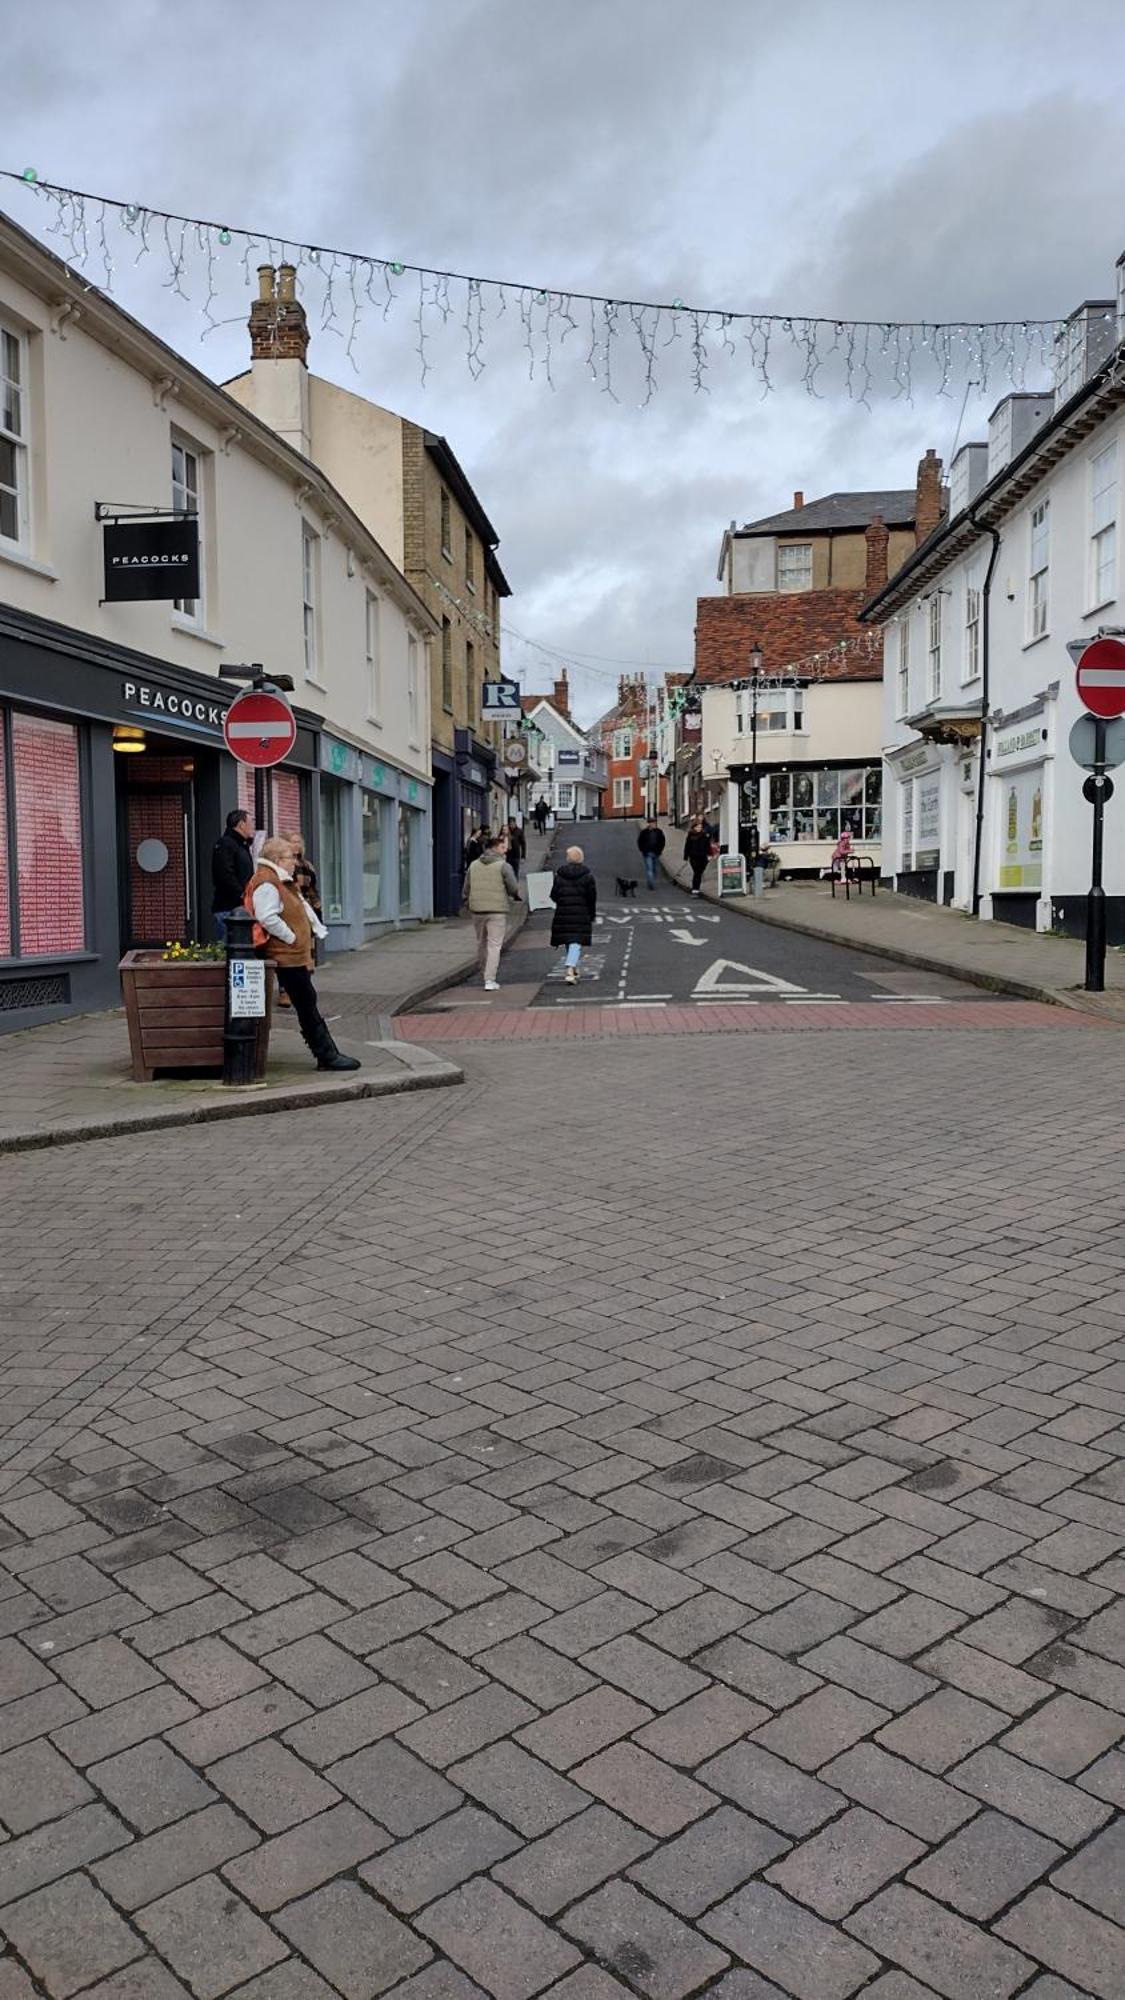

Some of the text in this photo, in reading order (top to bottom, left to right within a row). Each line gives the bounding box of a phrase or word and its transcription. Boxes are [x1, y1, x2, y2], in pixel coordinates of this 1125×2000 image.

[112, 554, 189, 565] PEACOCKS
[486, 684, 517, 706] R
[125, 682, 227, 725] PEACOCKS
[236, 963, 243, 974] P
